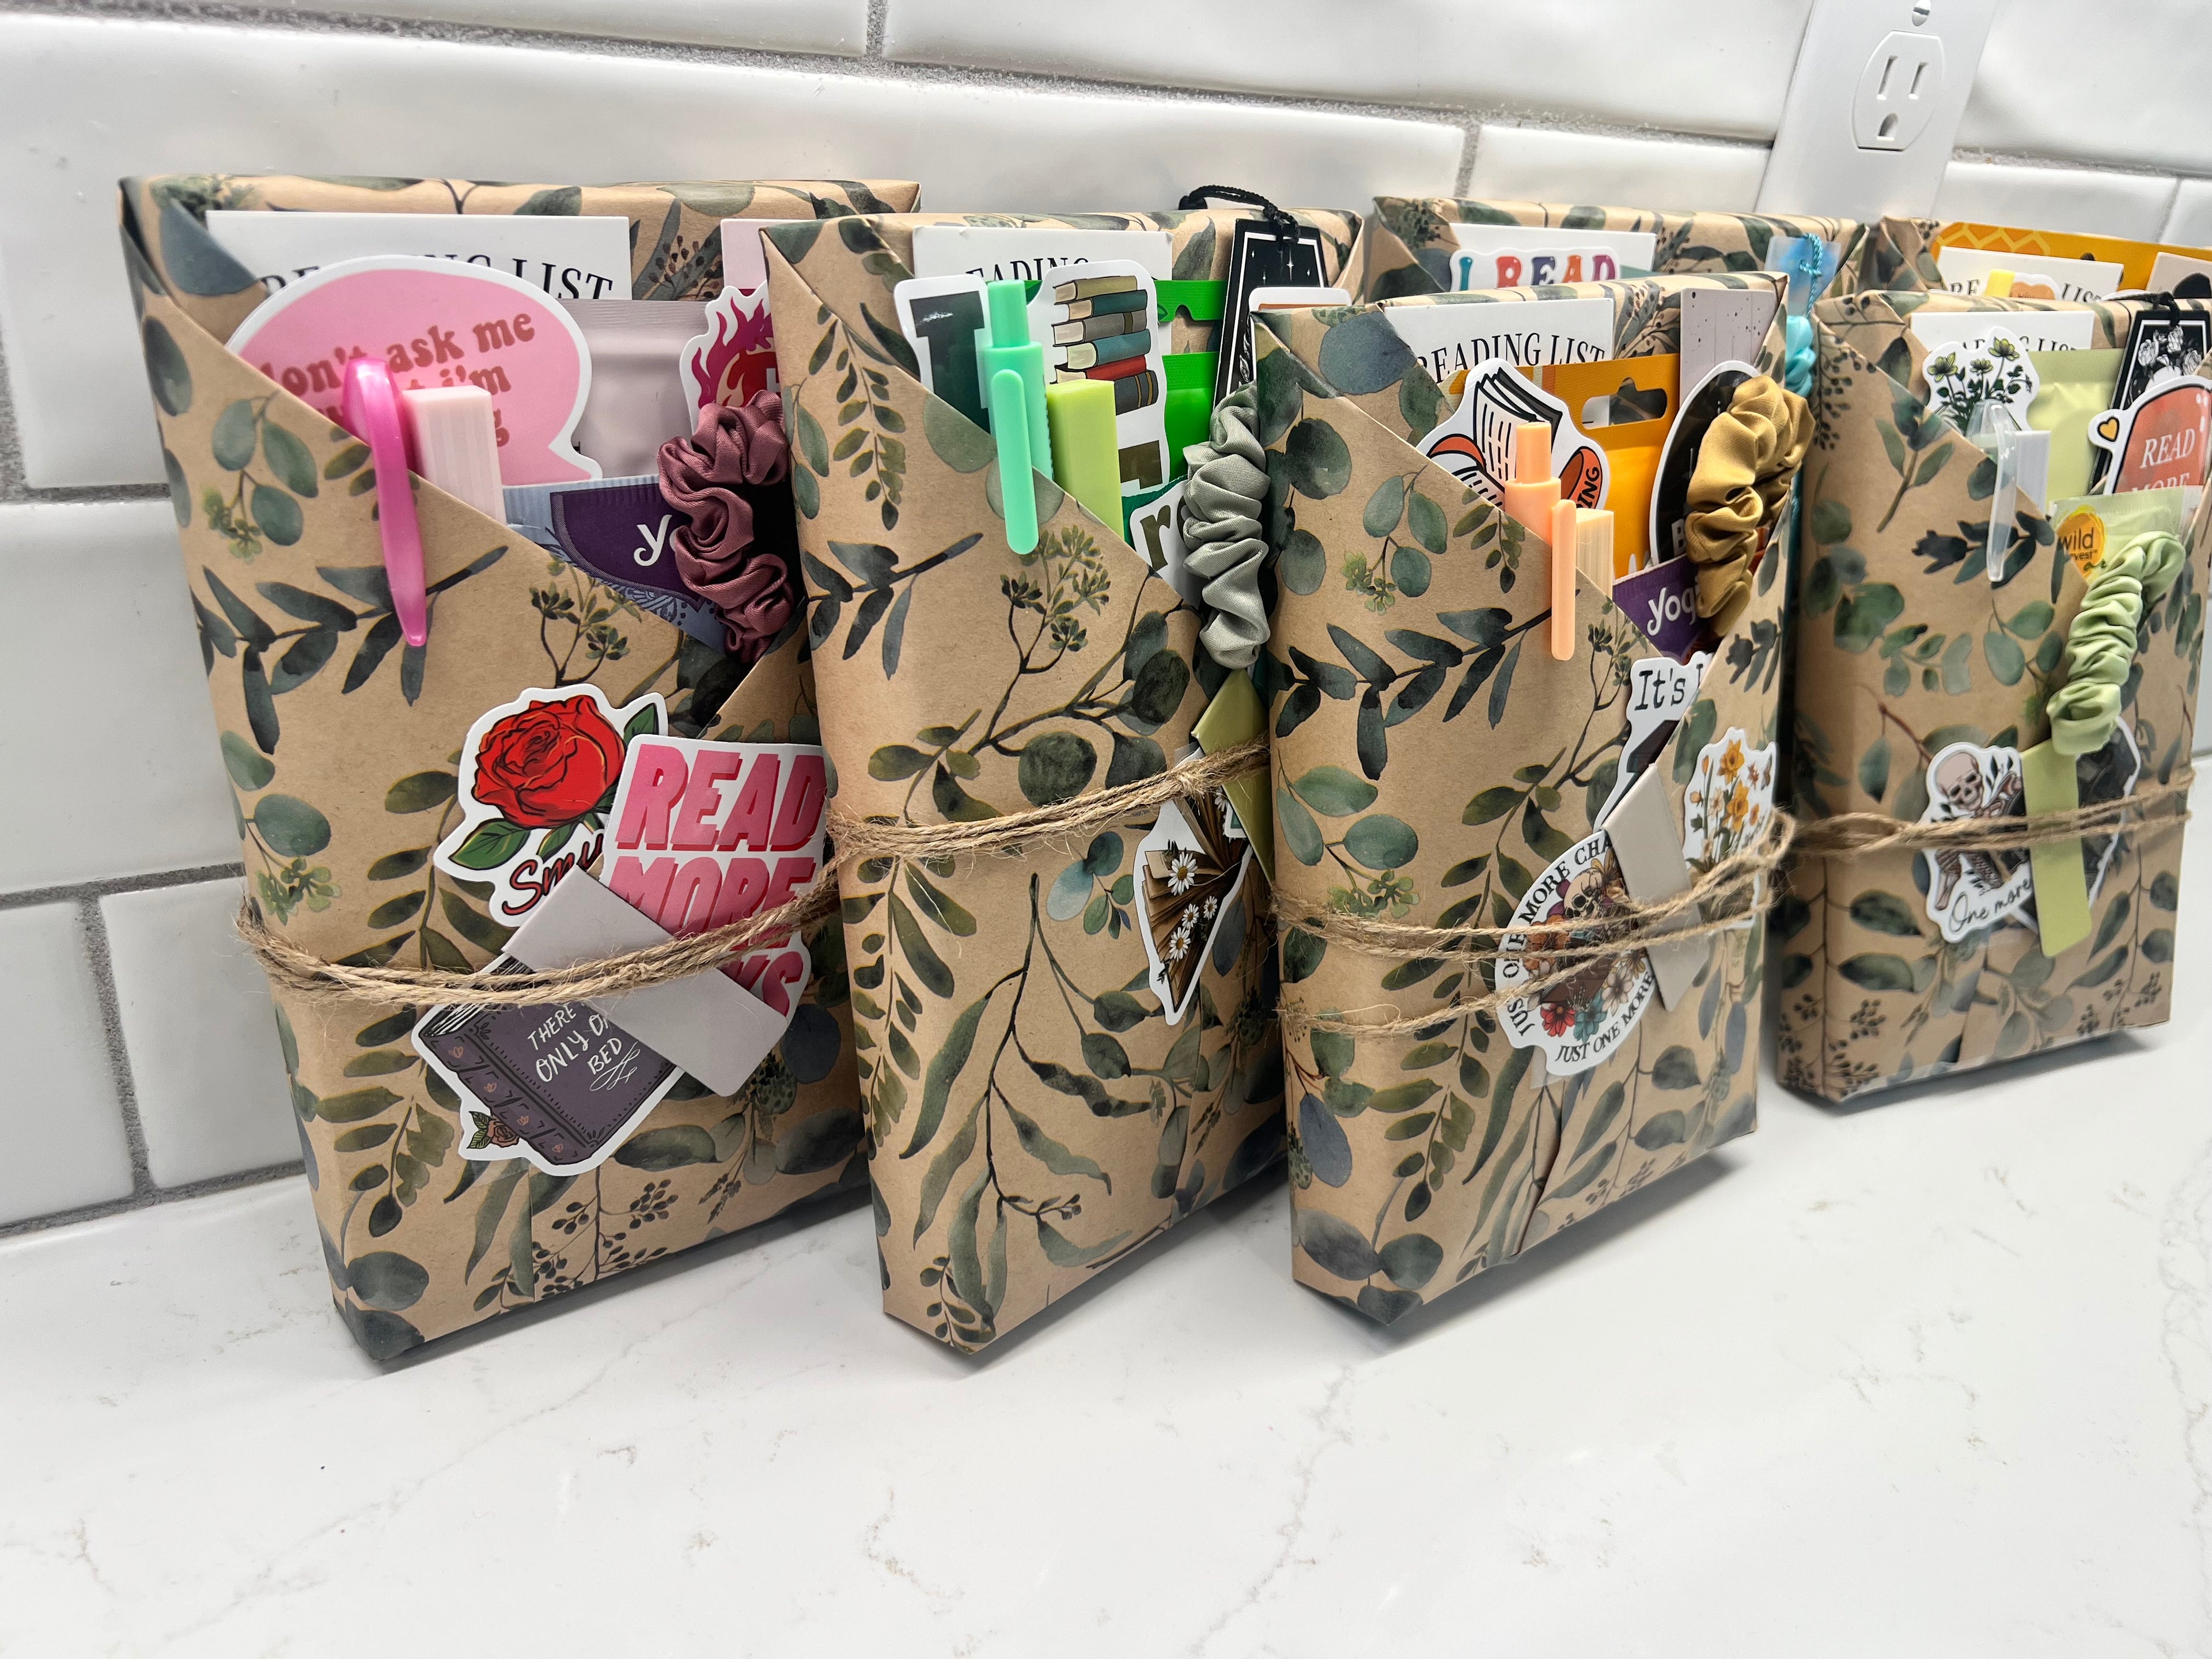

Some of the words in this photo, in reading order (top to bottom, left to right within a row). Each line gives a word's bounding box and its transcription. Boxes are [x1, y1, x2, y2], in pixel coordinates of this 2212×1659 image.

[388, 325, 465, 373] ask
[472, 313, 535, 353] me
[2139, 428, 2195, 469] READ
[1634, 667, 1686, 711] It's
[615, 744, 830, 852] READ
[1518, 861, 1570, 925] MORE
[1949, 891, 1990, 932] One
[1995, 878, 2031, 914] more
[1507, 998, 1535, 1036] JUS
[1555, 1043, 1590, 1063] JUST
[1593, 1021, 1620, 1053] ONE
[1621, 972, 1655, 1028] MORE
[536, 1030, 589, 1082] ONLY
[588, 1037, 622, 1075] BED
